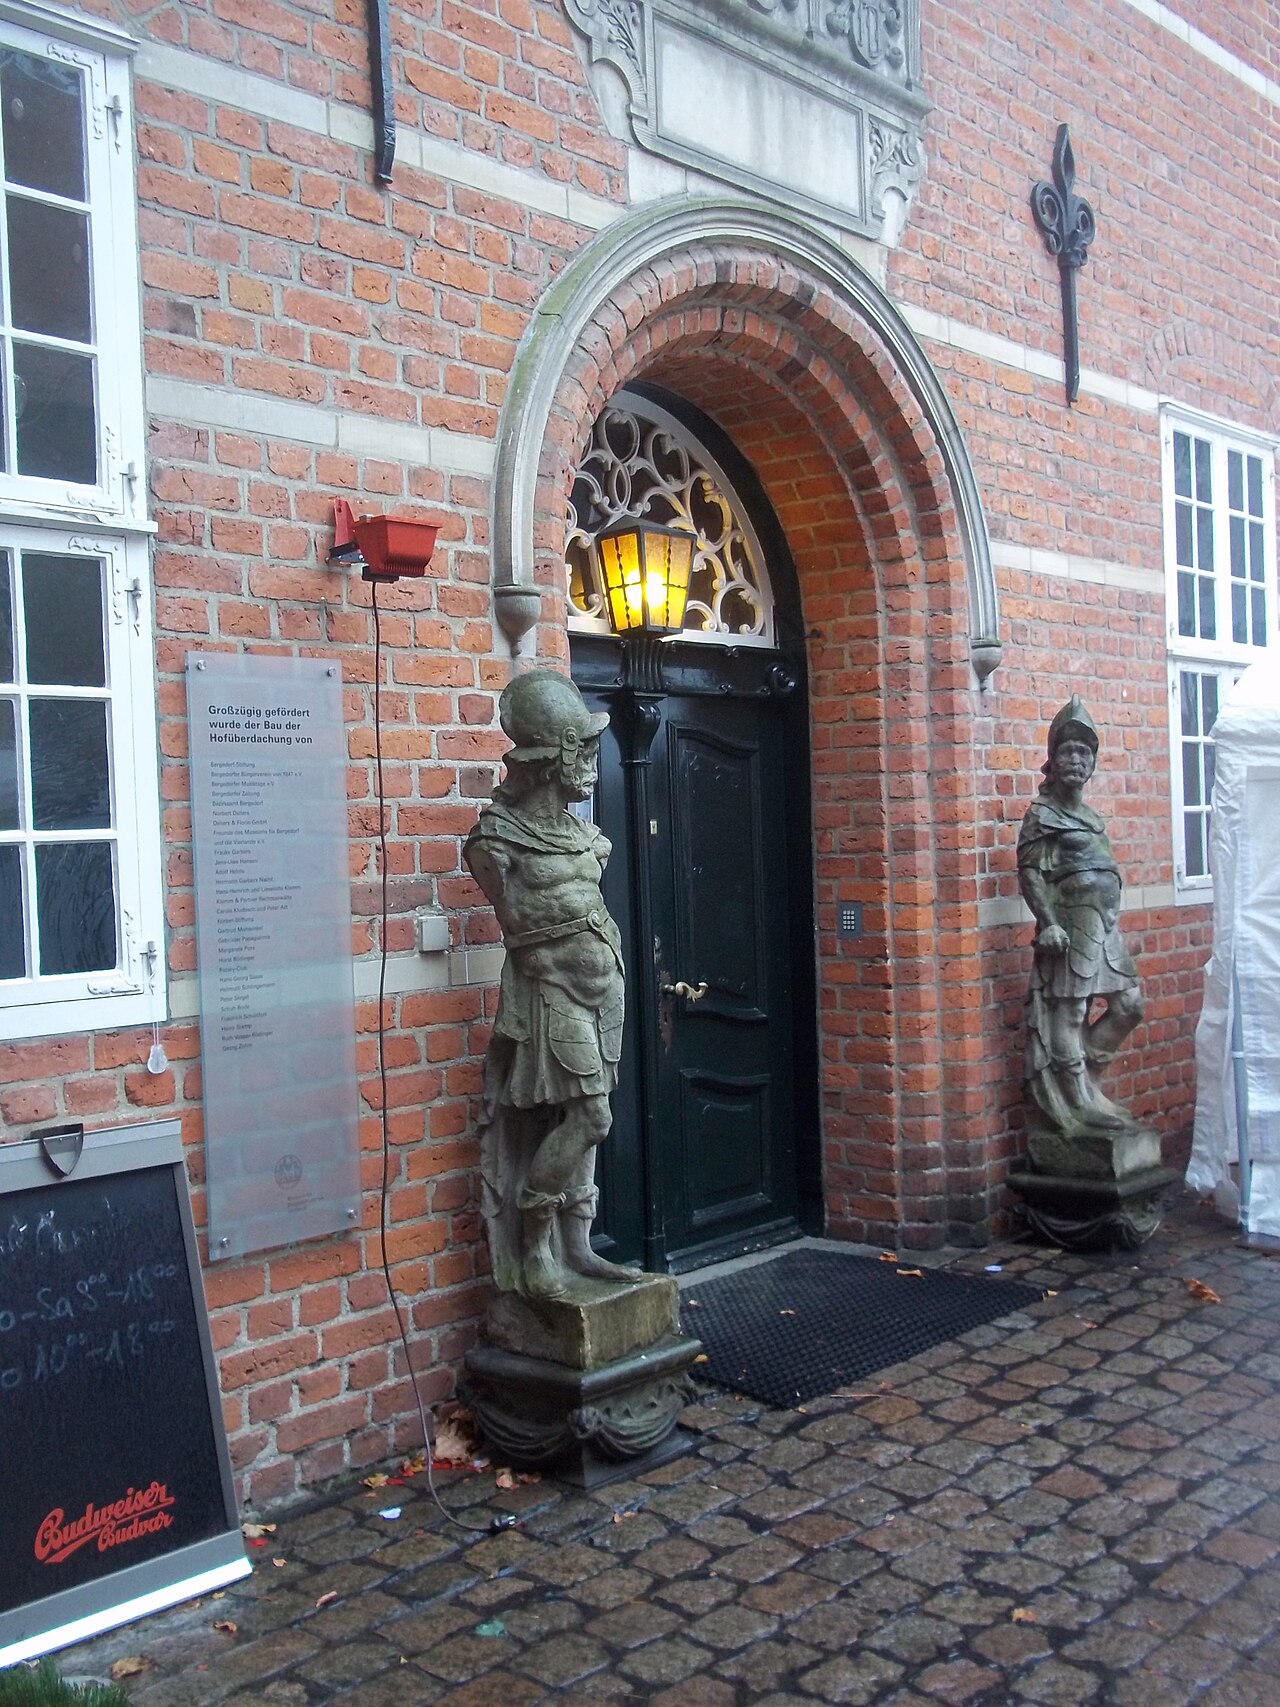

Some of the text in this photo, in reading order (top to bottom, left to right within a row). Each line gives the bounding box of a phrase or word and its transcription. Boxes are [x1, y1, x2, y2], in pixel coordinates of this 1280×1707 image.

[208, 705, 310, 718] Großzügig gefördert
[209, 720, 301, 730] wurde der Bau der
[209, 733, 292, 746] Hofüberdachung
[34, 1481, 175, 1563] Budweiser
[97, 1511, 175, 1552] Budvar
